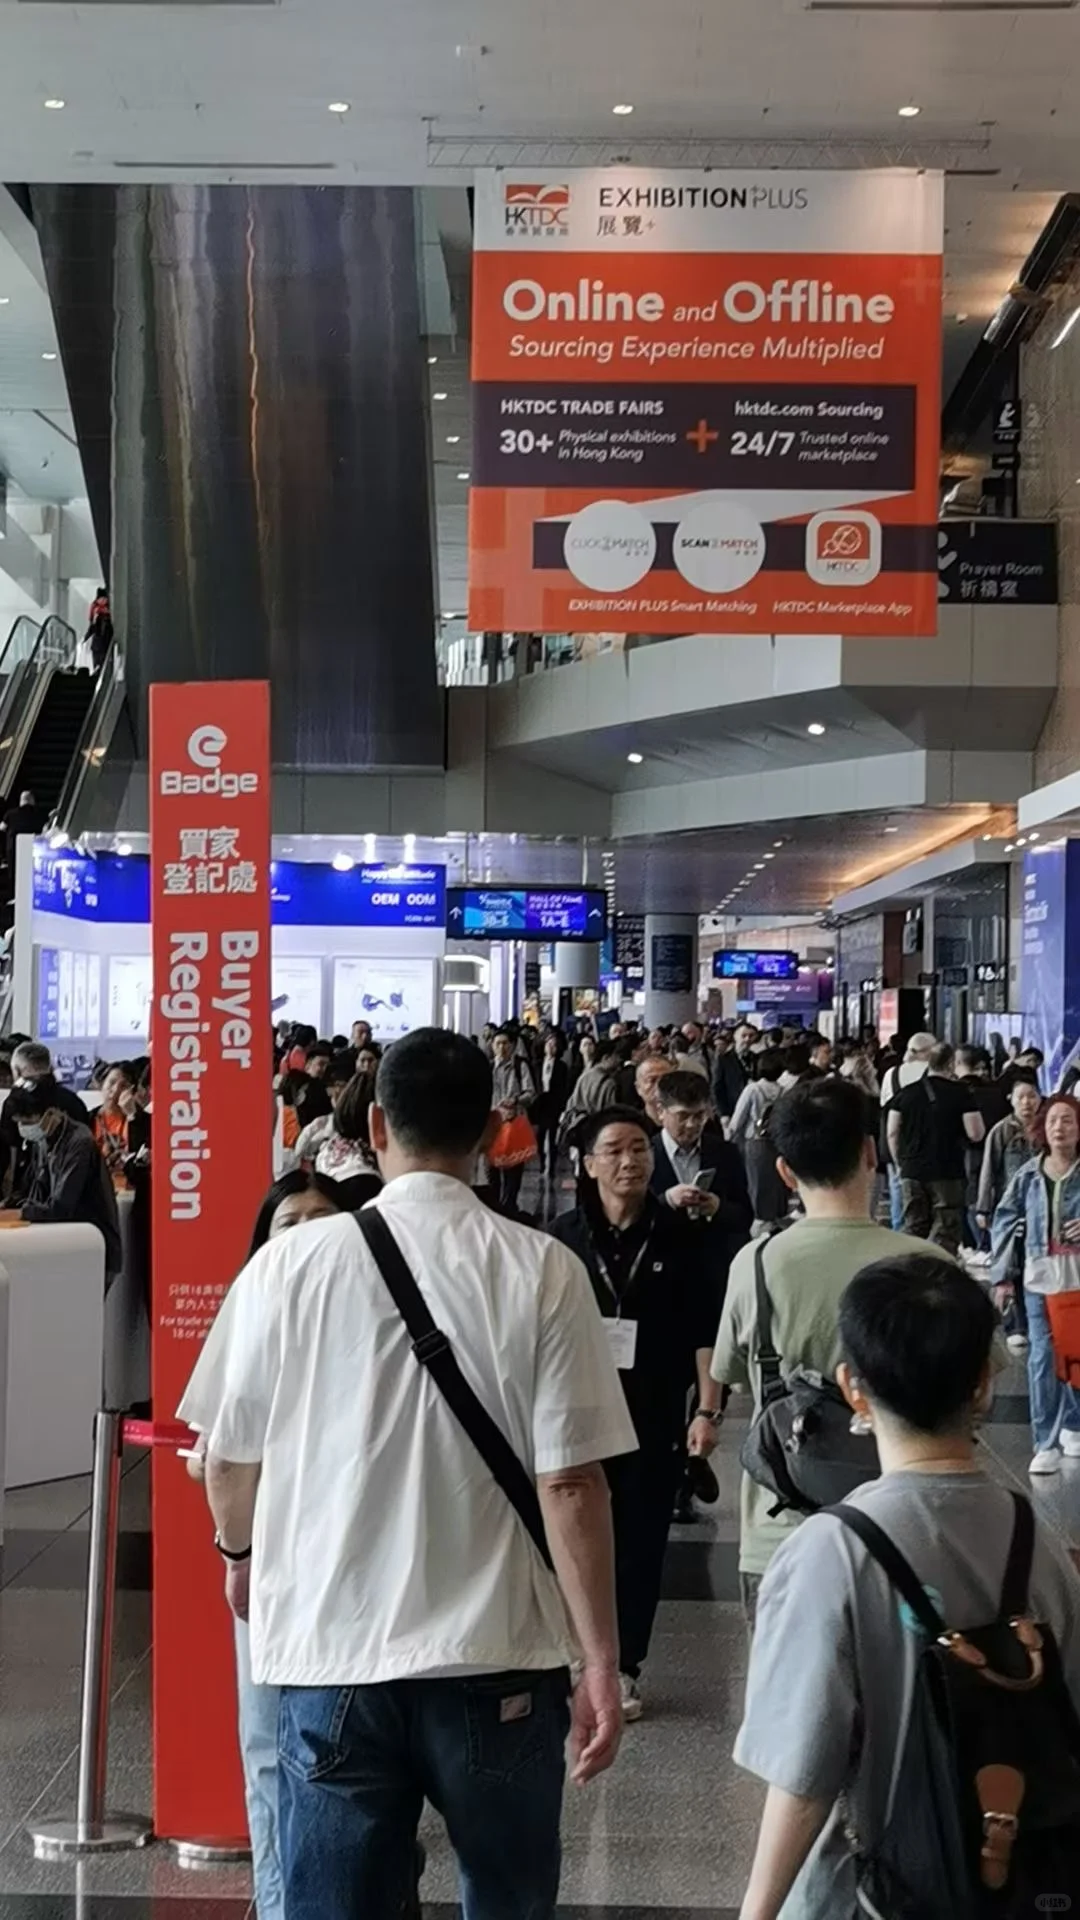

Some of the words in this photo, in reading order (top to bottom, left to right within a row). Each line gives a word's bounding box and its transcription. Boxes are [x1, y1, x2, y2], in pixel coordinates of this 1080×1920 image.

[599, 187, 746, 208] EXHIBITION
[505, 207, 568, 226] HKTDC
[503, 278, 665, 321] Online
[673, 300, 718, 322] and
[724, 279, 895, 324] Offline
[509, 334, 614, 364] Sourcing
[621, 336, 755, 366] Experience
[762, 336, 885, 366] Multiplied
[501, 399, 557, 414] HKTDC
[561, 400, 614, 415] TRADE
[619, 400, 664, 415] FAIRS
[735, 401, 814, 416] hktdc.com
[818, 402, 883, 420] Sourcing
[500, 429, 553, 454] 30+
[559, 429, 608, 444] Physical
[610, 430, 676, 443] exhibitions
[731, 431, 795, 456] 24/7
[800, 431, 847, 444] Trusted
[850, 432, 889, 445] online
[558, 447, 570, 459] in
[573, 448, 607, 463] Hong
[610, 448, 643, 463] Kong
[798, 450, 877, 465] marketplace
[960, 562, 1002, 576] Prayer
[1005, 562, 1043, 575] Room
[569, 599, 636, 611] EXHIBITION
[639, 599, 668, 612] PLUS
[670, 600, 703, 612] Smart
[705, 600, 757, 615] Matching
[773, 601, 816, 614] HKTDC
[817, 602, 886, 616] Marketplace
[888, 602, 913, 617] App
[161, 768, 258, 798] Badge
[180, 827, 241, 860] 買家
[163, 862, 258, 895] 登記處
[371, 893, 400, 906] OEM
[406, 893, 436, 906] ODM
[212, 930, 259, 1069] Buyer
[160, 931, 211, 1220] Registration
